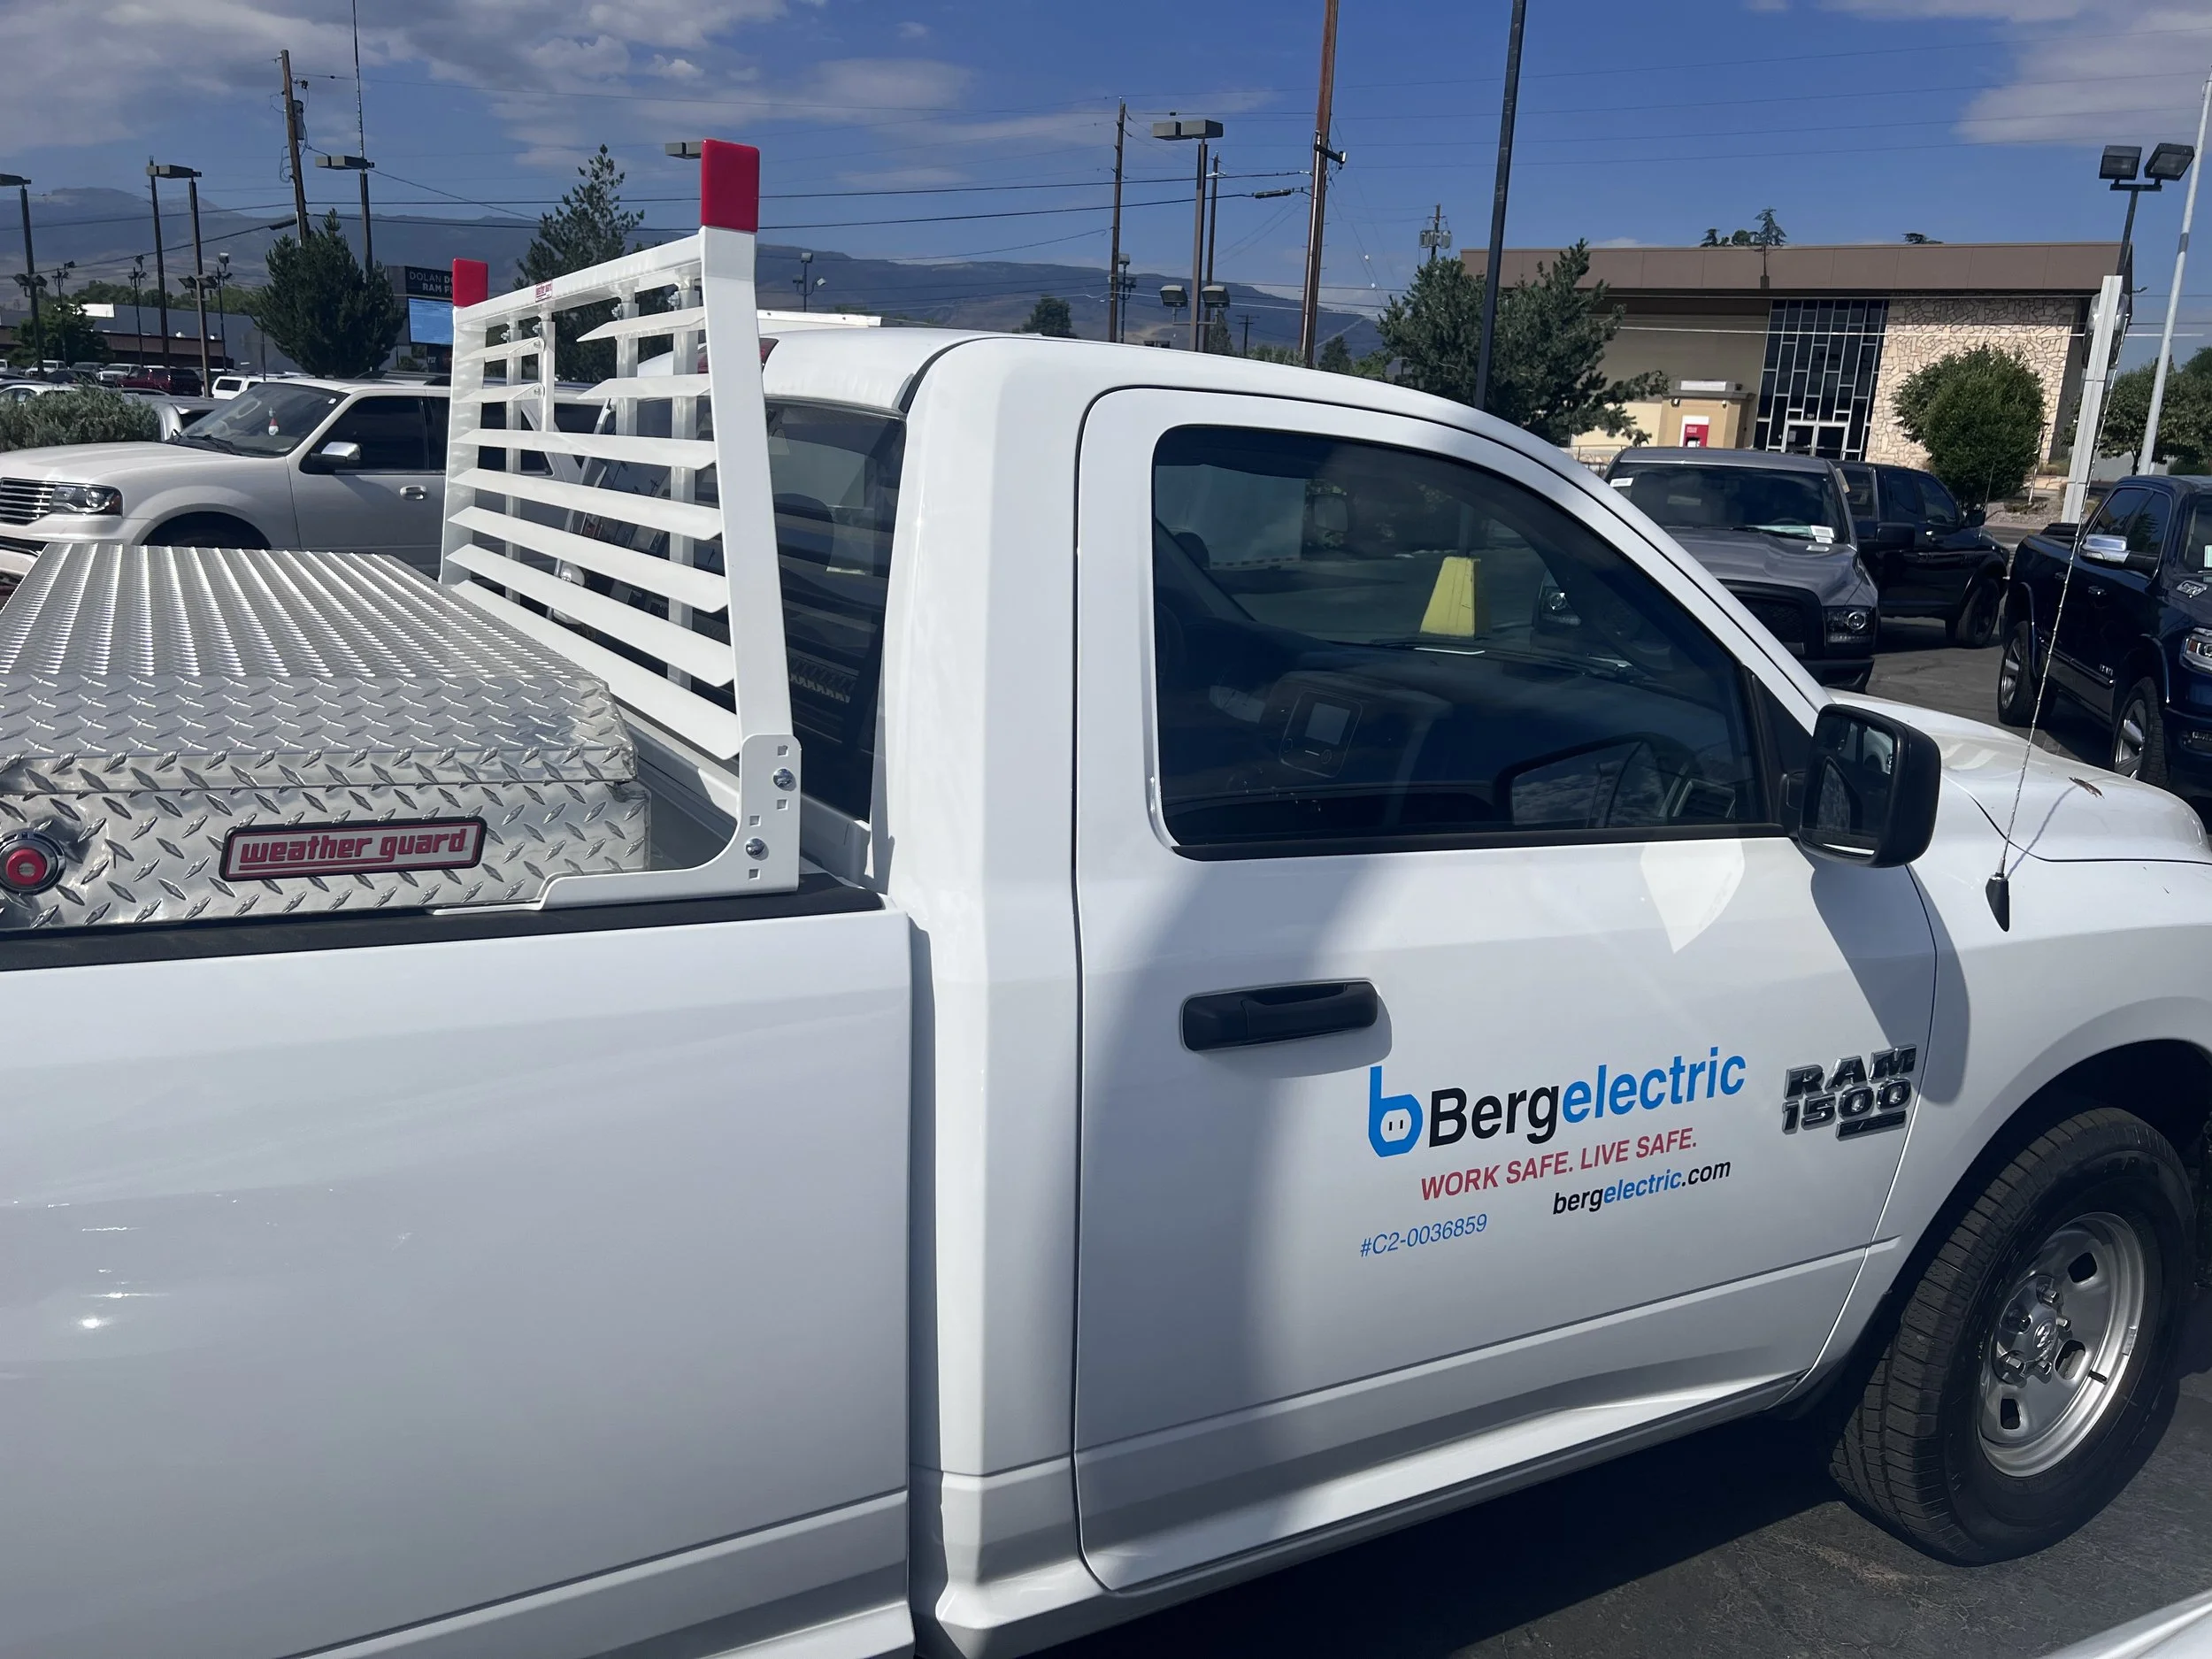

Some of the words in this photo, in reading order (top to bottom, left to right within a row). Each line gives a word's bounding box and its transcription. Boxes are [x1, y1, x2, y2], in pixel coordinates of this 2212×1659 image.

[409, 271, 442, 283] DOLAN
[422, 283, 442, 294] RAM
[240, 835, 373, 864] weather
[379, 828, 467, 863] guard
[1429, 1046, 1747, 1148] Bergelectric
[1784, 1043, 1917, 1100] RAM
[1782, 1078, 1913, 1135] 1500
[1421, 1164, 1501, 1201] WORK
[1506, 1151, 1574, 1185] SAFE.
[1580, 1139, 1630, 1170] LIVE
[1635, 1127, 1697, 1159] SAFE.
[1553, 1161, 1732, 1215] bergelectric.com
[1360, 1213, 1488, 1257] #C2-0036859
